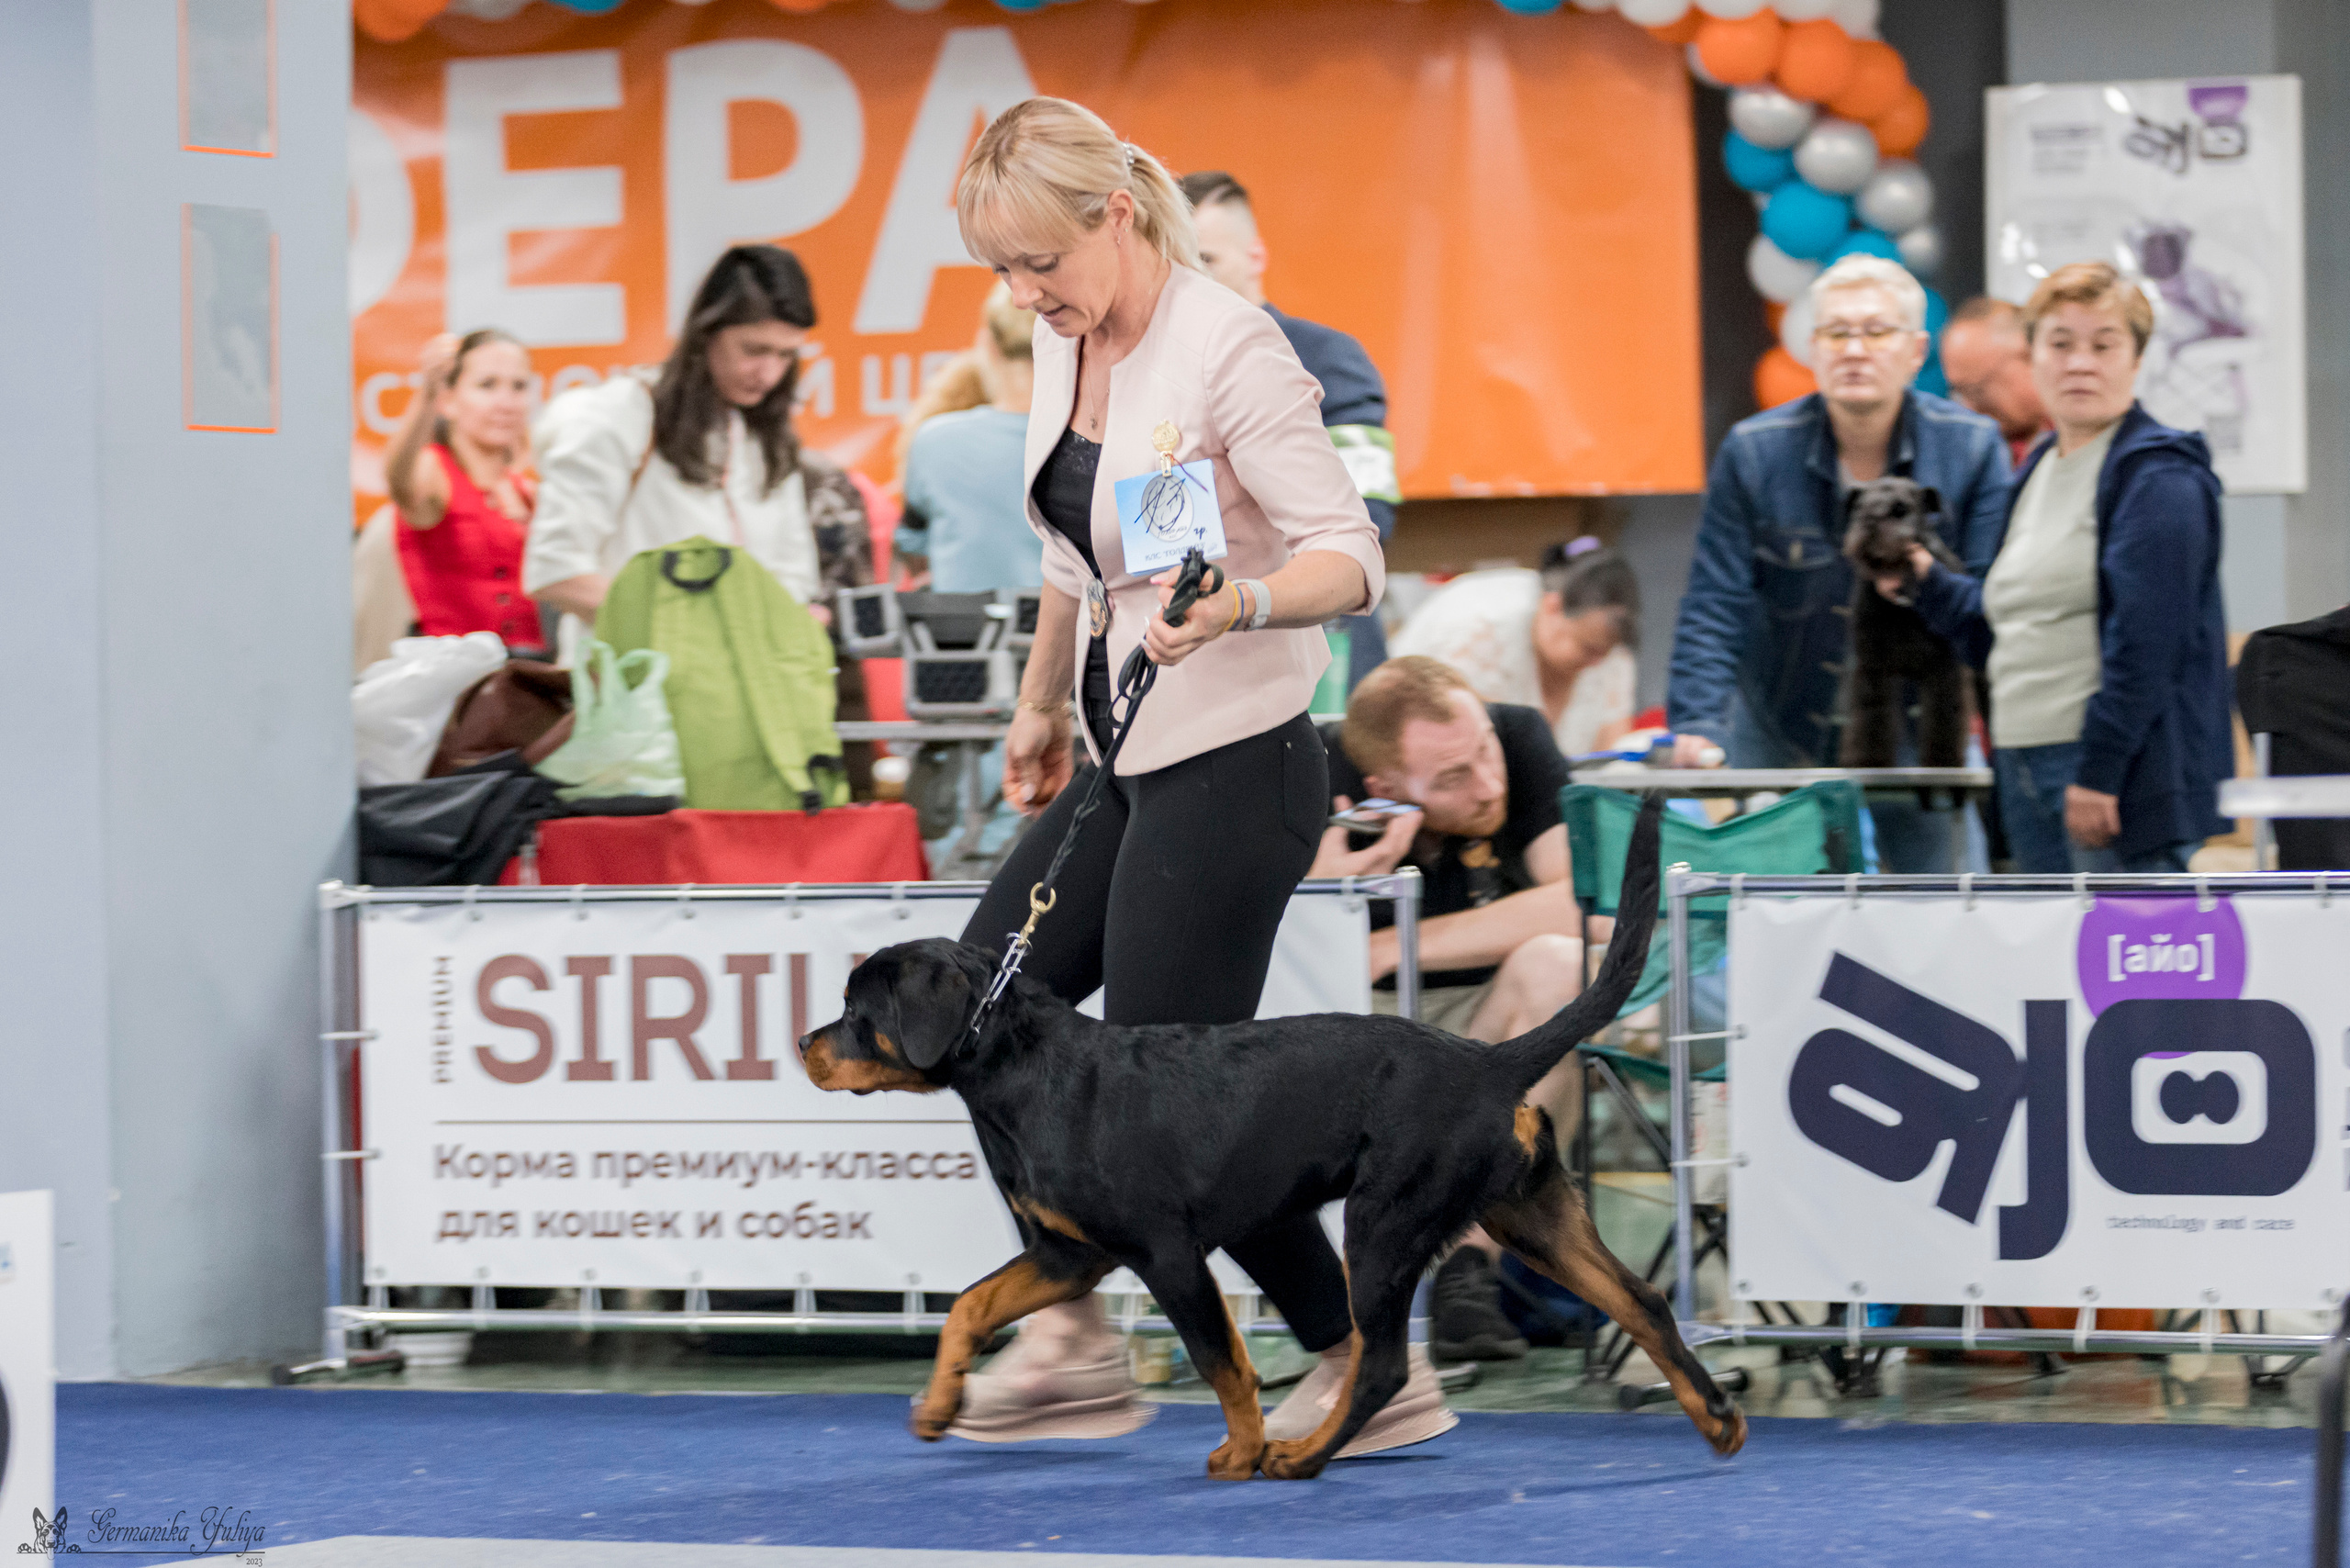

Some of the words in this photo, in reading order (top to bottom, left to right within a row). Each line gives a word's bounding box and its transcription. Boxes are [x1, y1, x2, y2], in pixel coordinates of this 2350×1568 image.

[2108, 933, 2215, 981] [айо]
[432, 956, 453, 1083] PREMIUM
[434, 1144, 576, 1188] Корма
[591, 1152, 979, 1188] премиум-класса
[435, 1210, 519, 1242] для
[532, 1210, 682, 1239] кошек
[695, 1210, 722, 1238] и
[738, 1200, 874, 1239] собак
[2212, 1215, 2247, 1230] and
